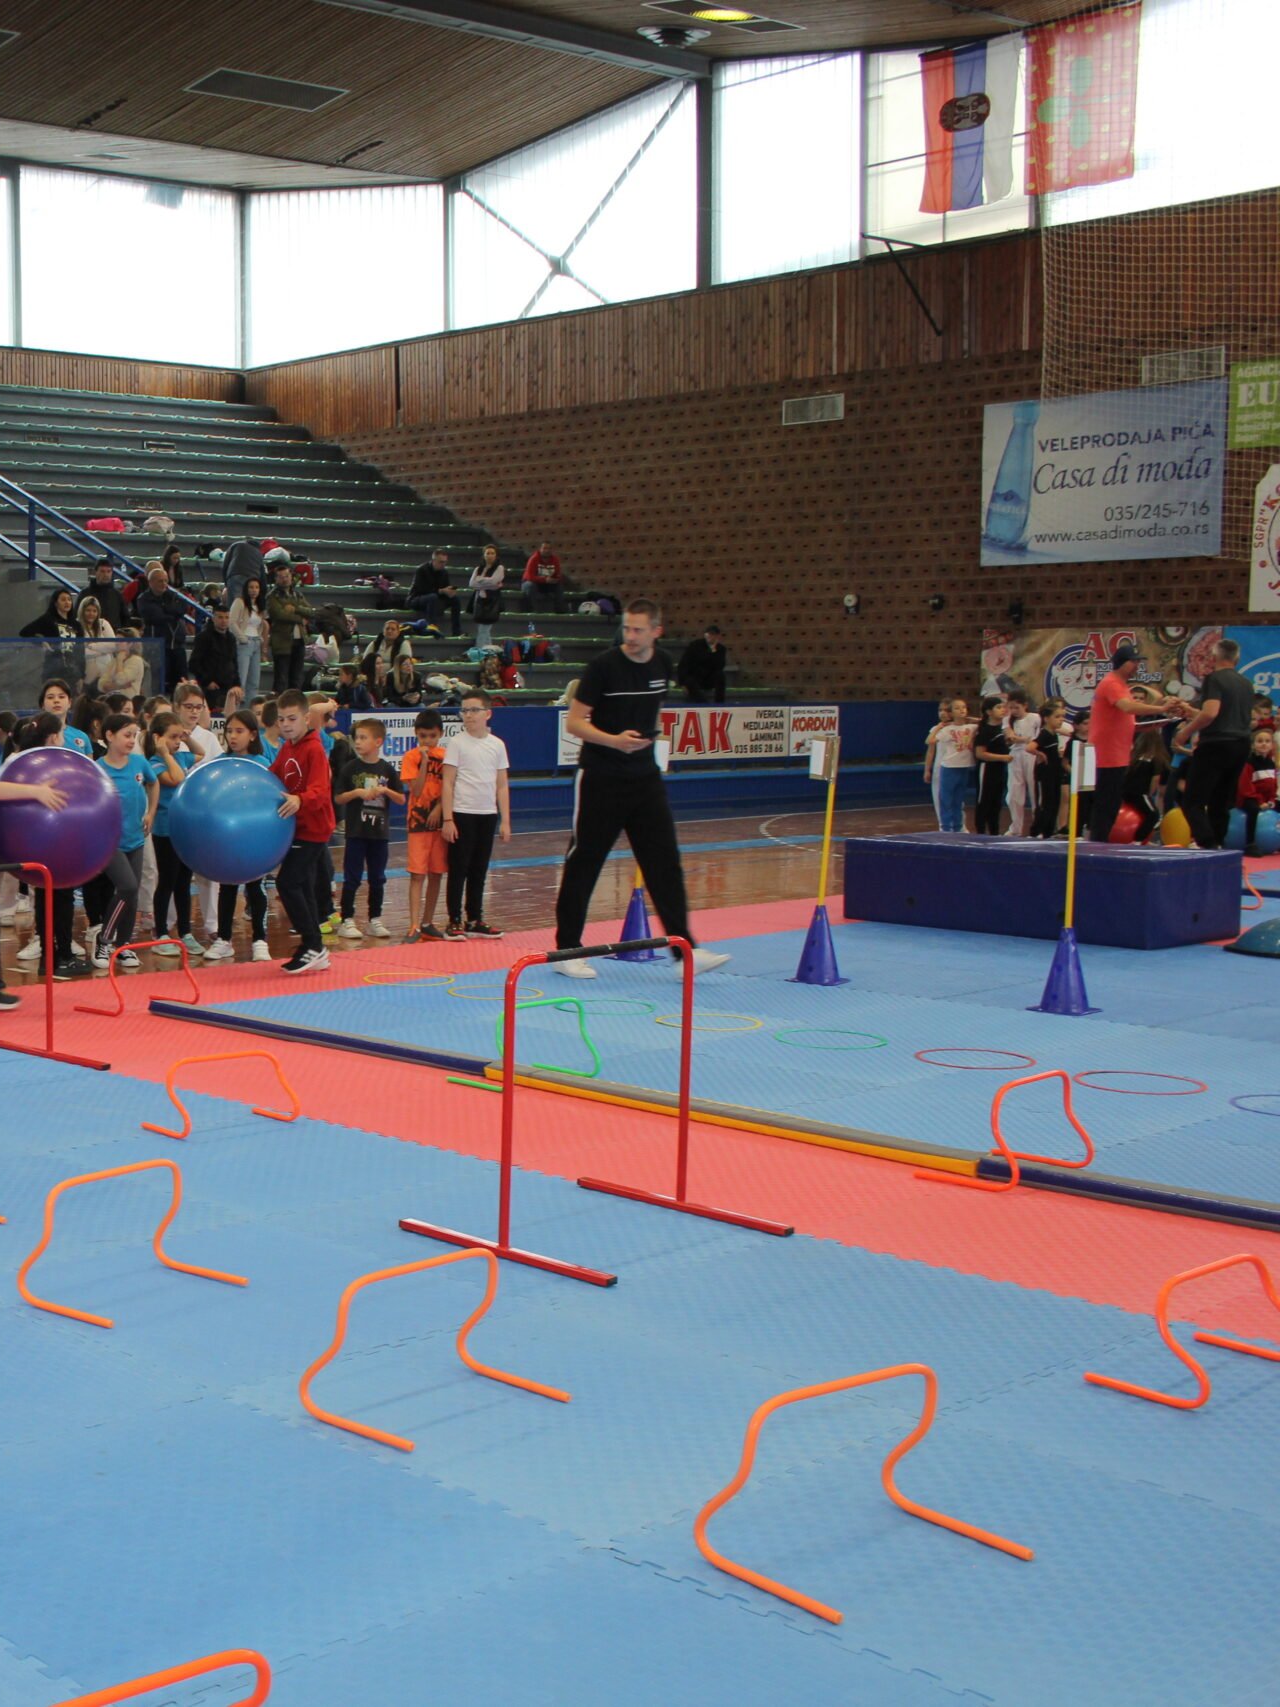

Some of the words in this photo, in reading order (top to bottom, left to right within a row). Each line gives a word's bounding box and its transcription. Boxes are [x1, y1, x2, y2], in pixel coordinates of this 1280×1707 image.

[1038, 429, 1165, 453] VELEPRODAJA
[1033, 463, 1095, 495] Casa
[1102, 452, 1132, 486] di
[1136, 447, 1212, 483] moda
[1104, 500, 1211, 522] 035/245-716
[1035, 523, 1210, 543] www.casadimoda.co.rs
[756, 709, 785, 719] IVERICA
[743, 721, 785, 732] MEDIJAPAN
[792, 716, 837, 731] KORDUN
[750, 732, 784, 742] LAMINATI
